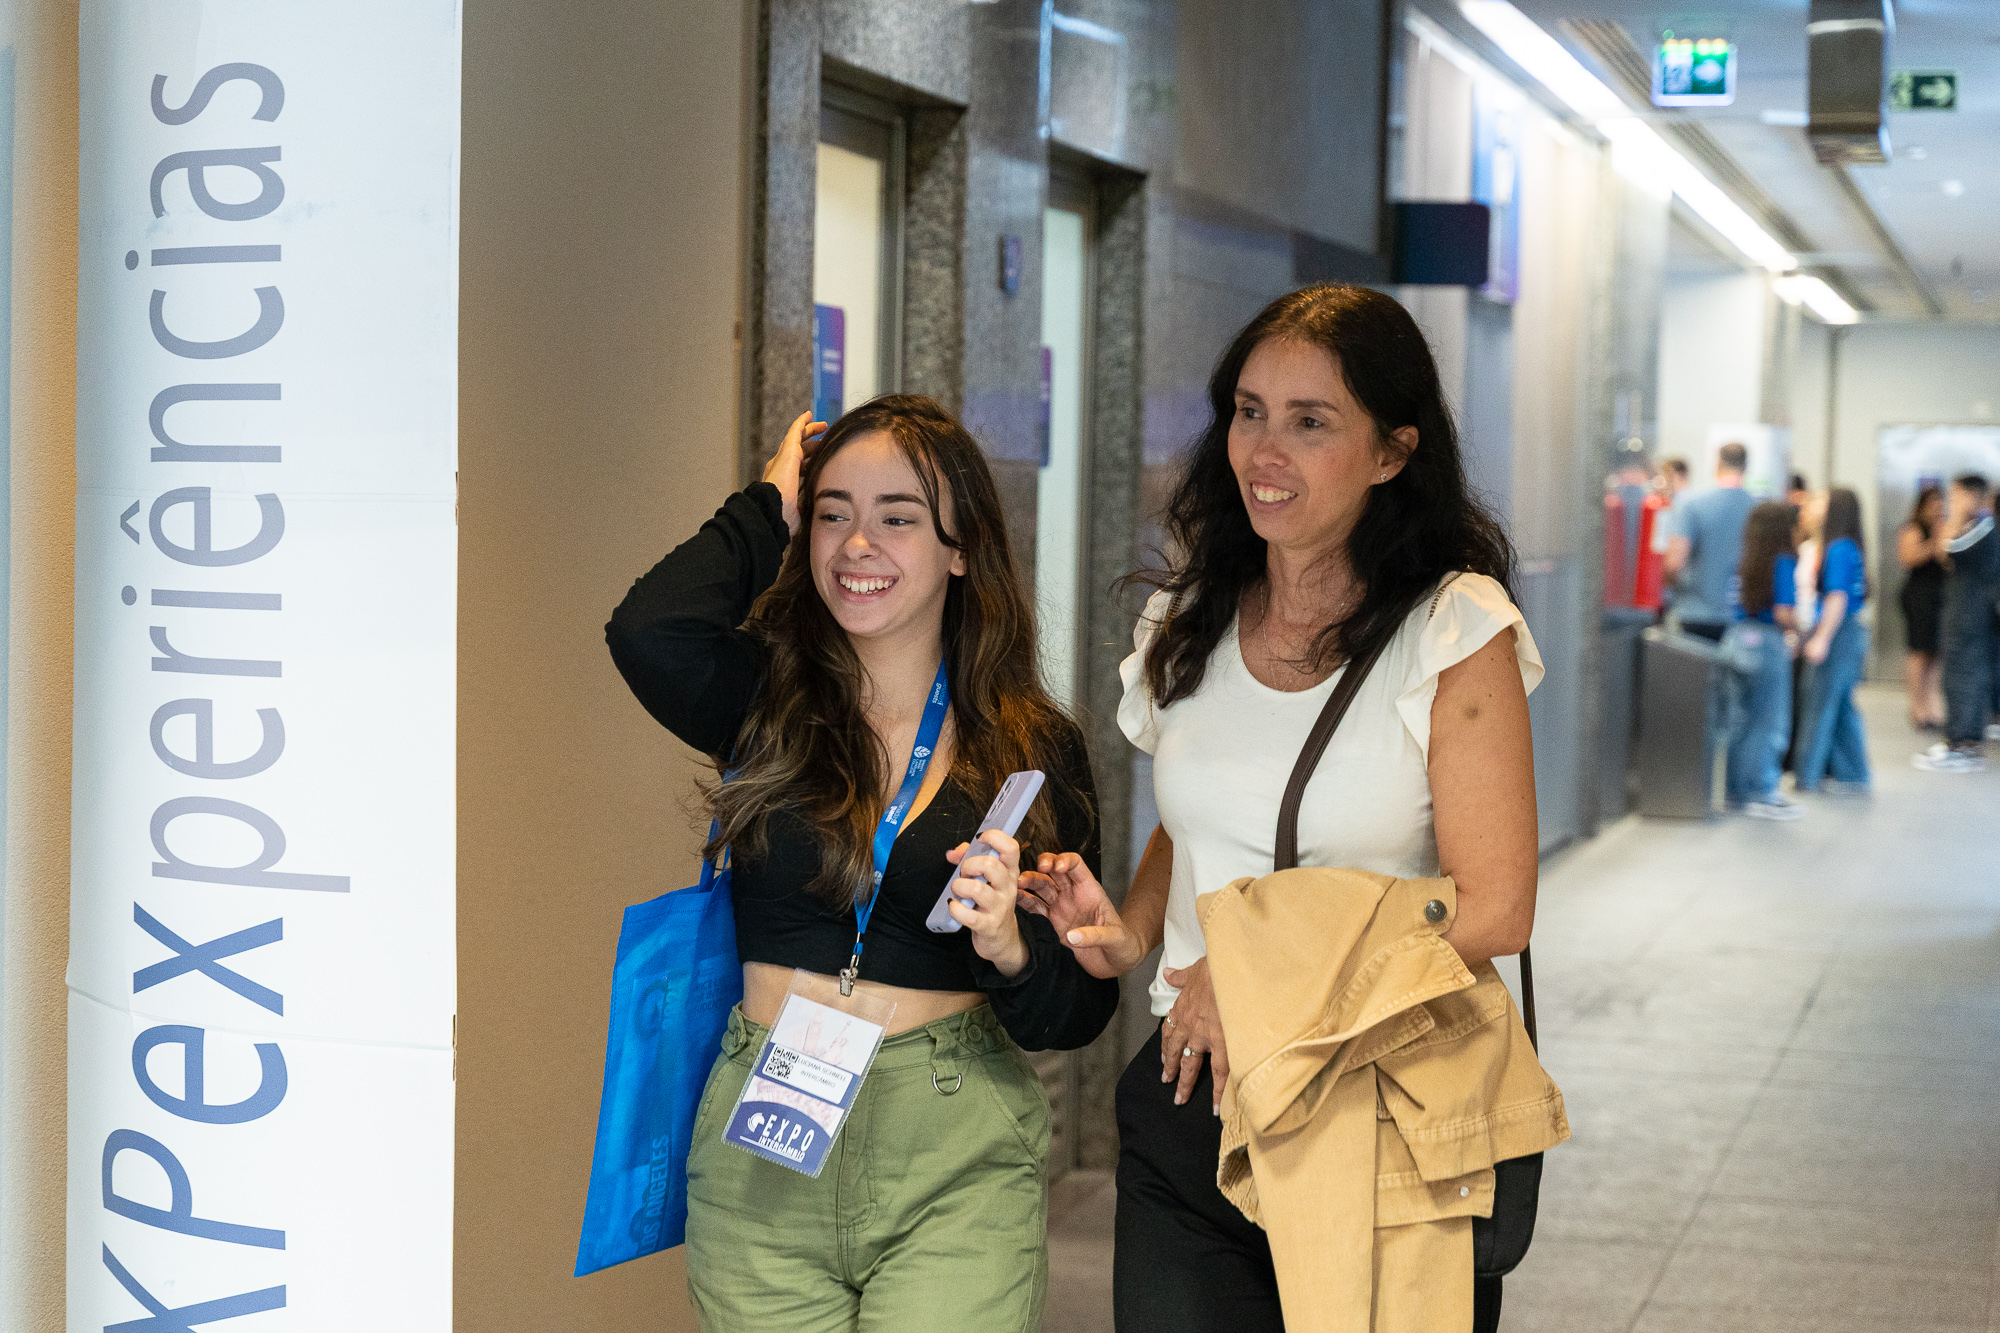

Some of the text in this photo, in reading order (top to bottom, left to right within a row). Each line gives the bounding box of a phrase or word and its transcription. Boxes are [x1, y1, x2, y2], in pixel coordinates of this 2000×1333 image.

[759, 1136, 805, 1160] INTERCAMBIO
[762, 1114, 815, 1152] EXPO
[646, 1134, 669, 1217] ANGELES
